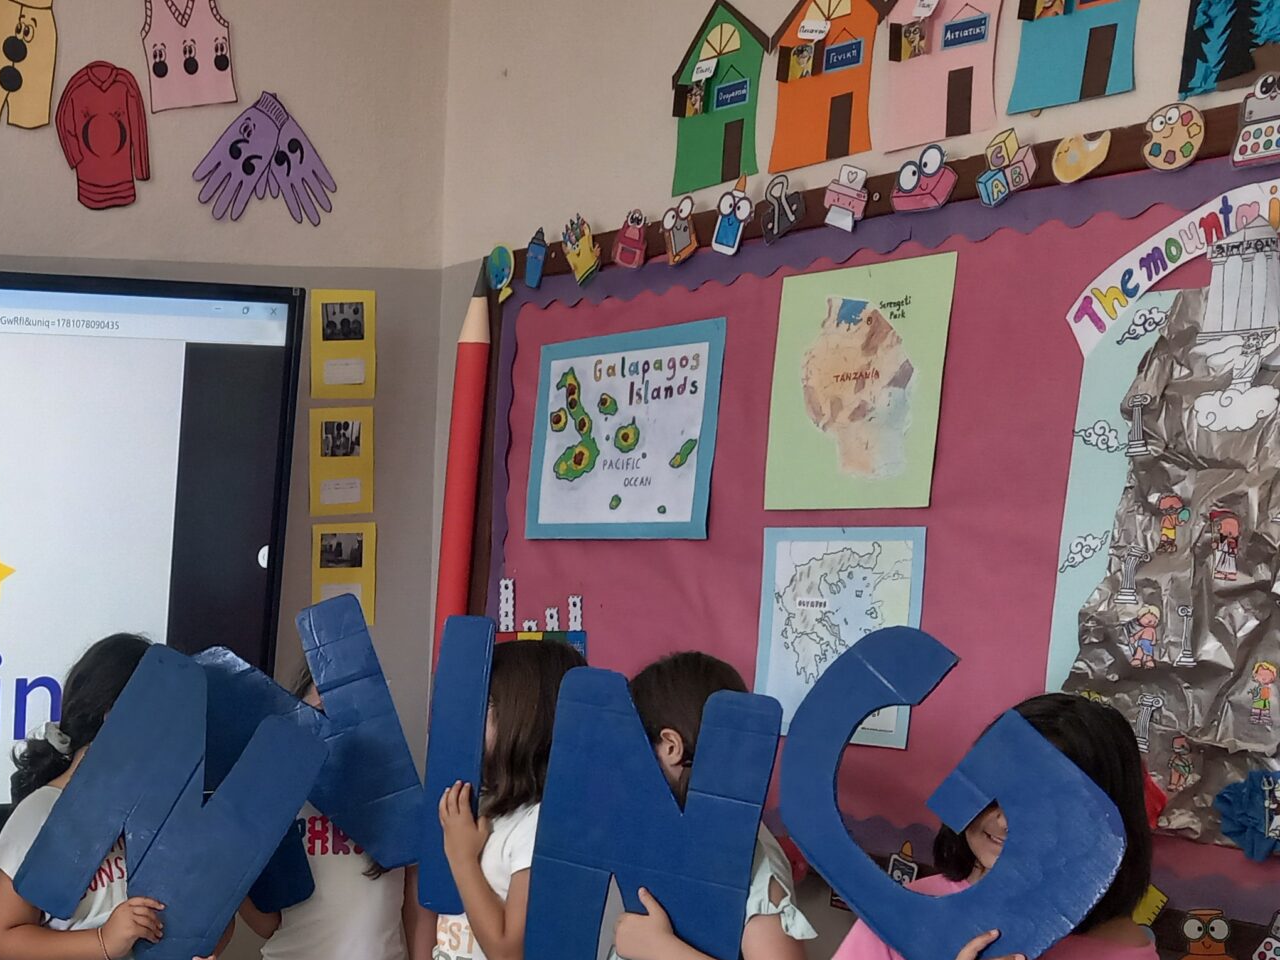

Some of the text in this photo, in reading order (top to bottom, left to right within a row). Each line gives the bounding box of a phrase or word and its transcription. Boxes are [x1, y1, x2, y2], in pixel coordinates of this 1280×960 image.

[829, 45, 857, 64] Γενική
[1010, 165, 1025, 188] B
[991, 178, 1007, 202] A
[1073, 268, 1139, 334] The
[889, 309, 906, 320] Park
[593, 352, 701, 382] Galapagos
[832, 369, 880, 383] TANZANIA
[628, 376, 699, 406] Islands
[602, 456, 641, 472] PACIFIC
[623, 476, 652, 488] OCEAN
